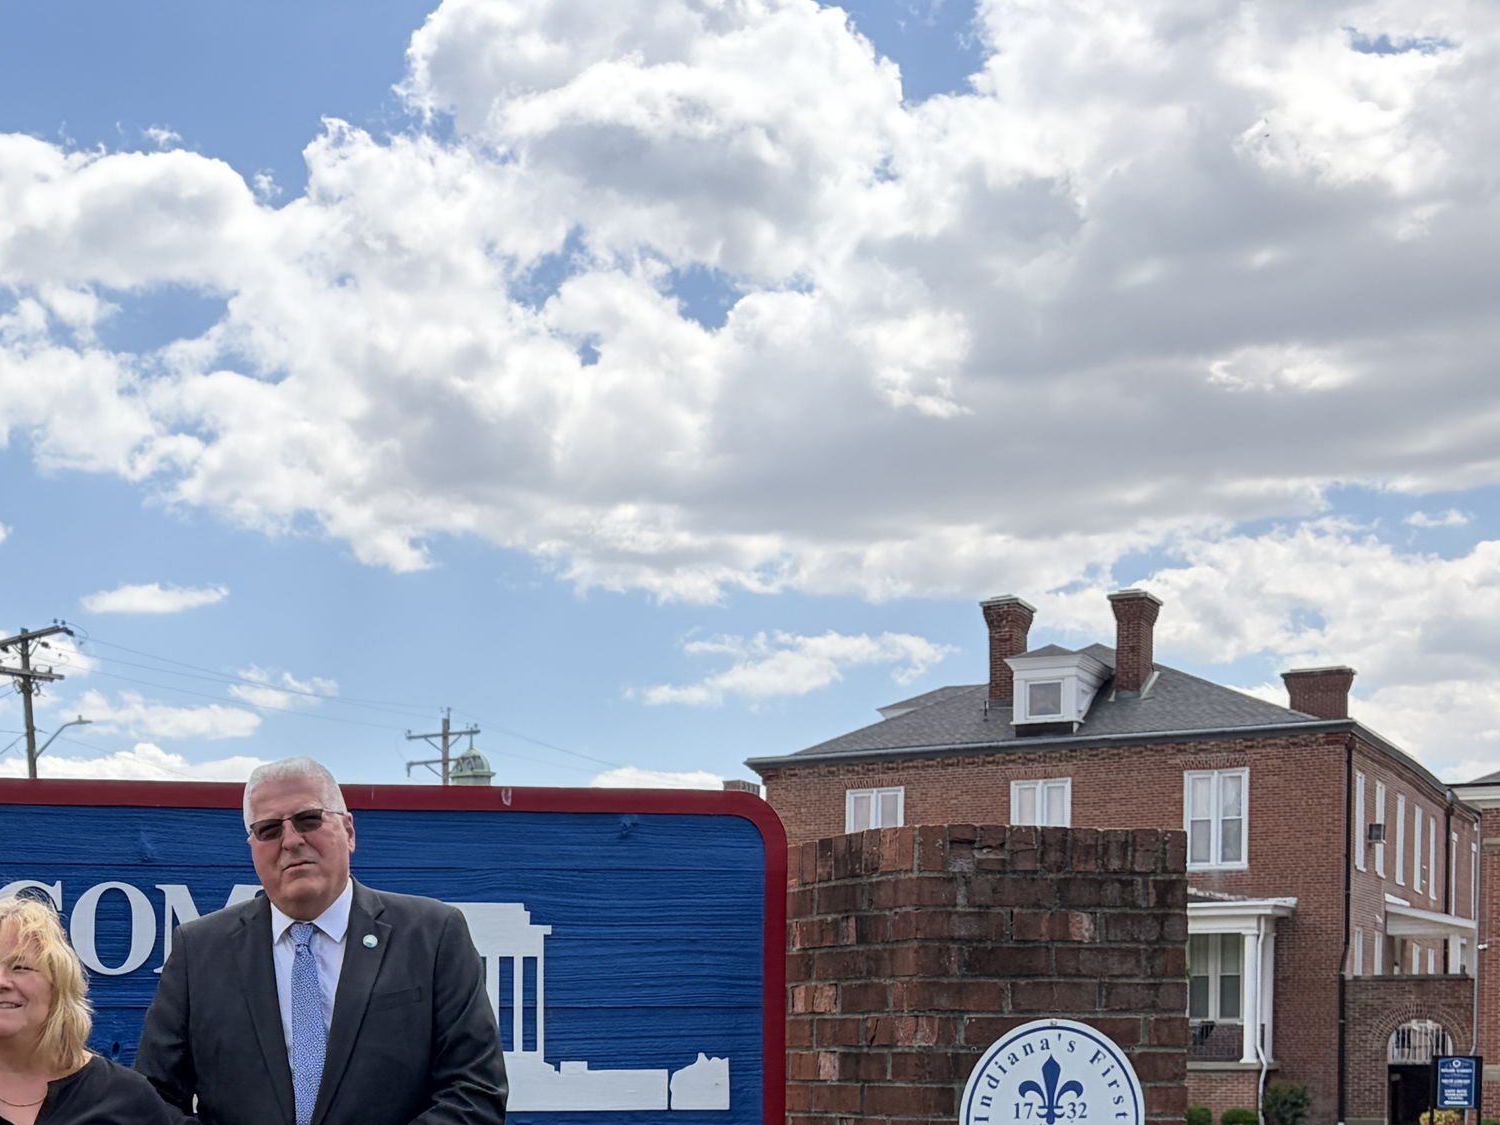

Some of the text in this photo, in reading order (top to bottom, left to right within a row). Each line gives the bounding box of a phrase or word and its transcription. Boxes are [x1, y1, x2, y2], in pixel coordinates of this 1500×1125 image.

[974, 1033, 1128, 1122] Indiana's First
[1013, 1102, 1088, 1119] 17 32
